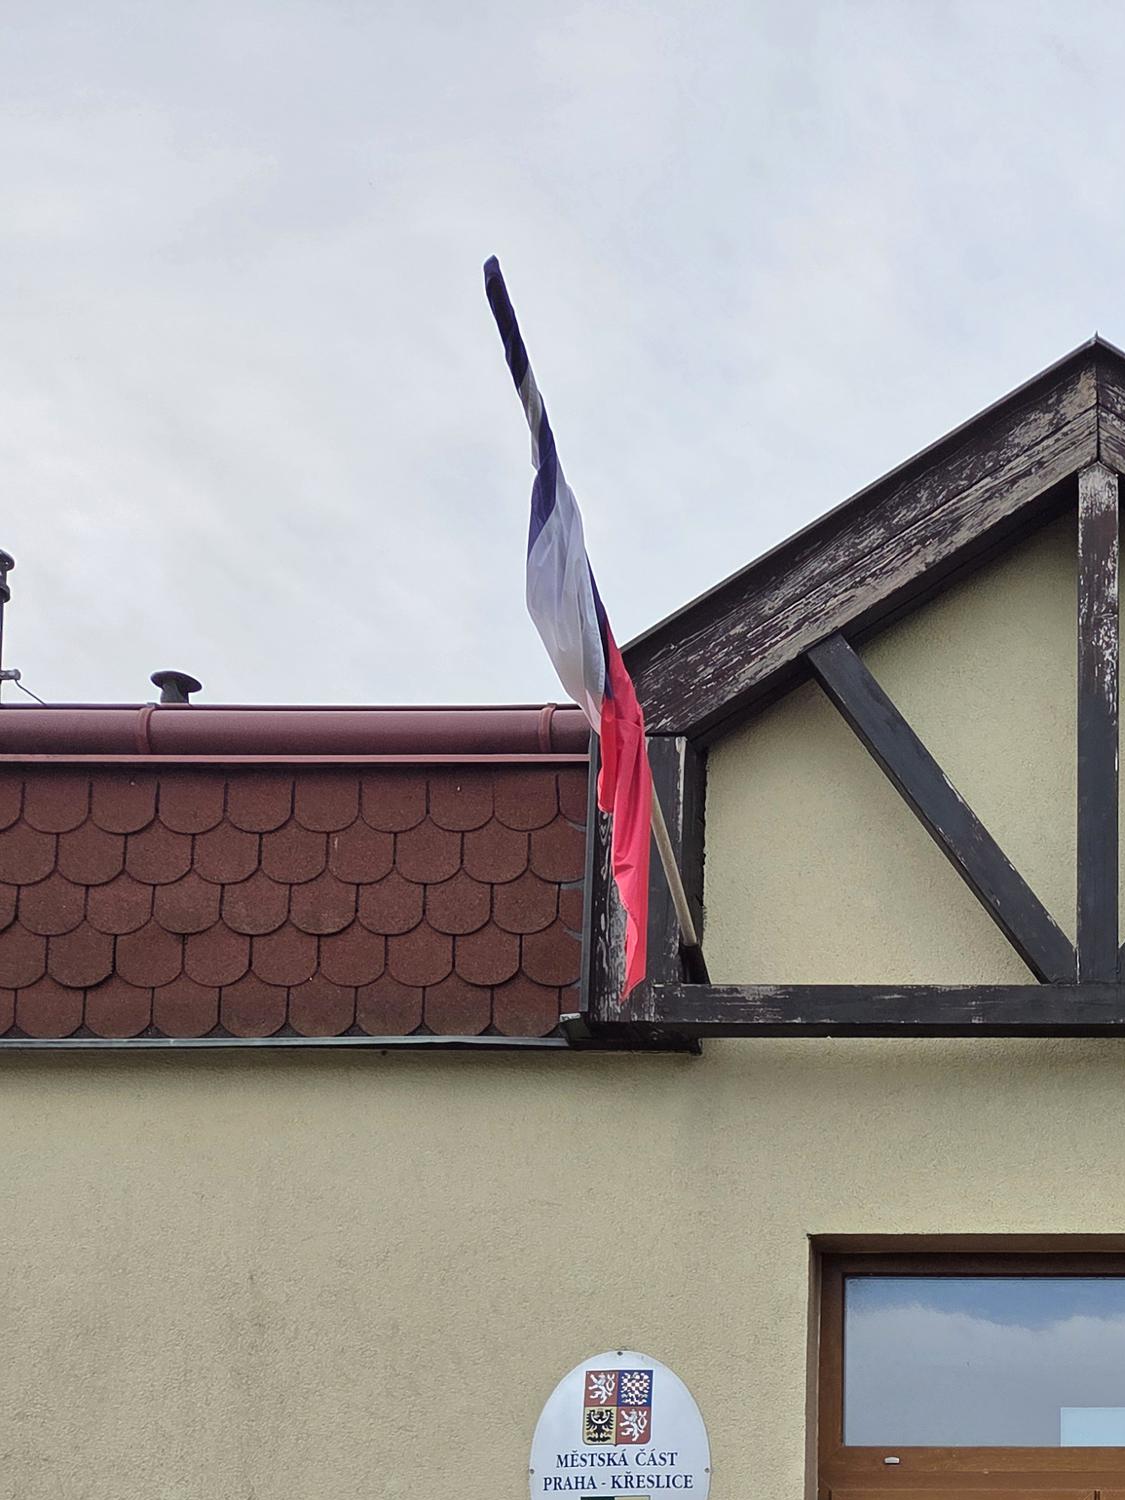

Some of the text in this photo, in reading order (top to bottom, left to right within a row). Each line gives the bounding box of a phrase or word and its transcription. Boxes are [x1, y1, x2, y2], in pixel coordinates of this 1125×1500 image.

[556, 1448, 678, 1468] MĚSTSKÁ ČÁST
[543, 1475, 597, 1491] PRAHA
[610, 1471, 694, 1490] KŘESLICE
